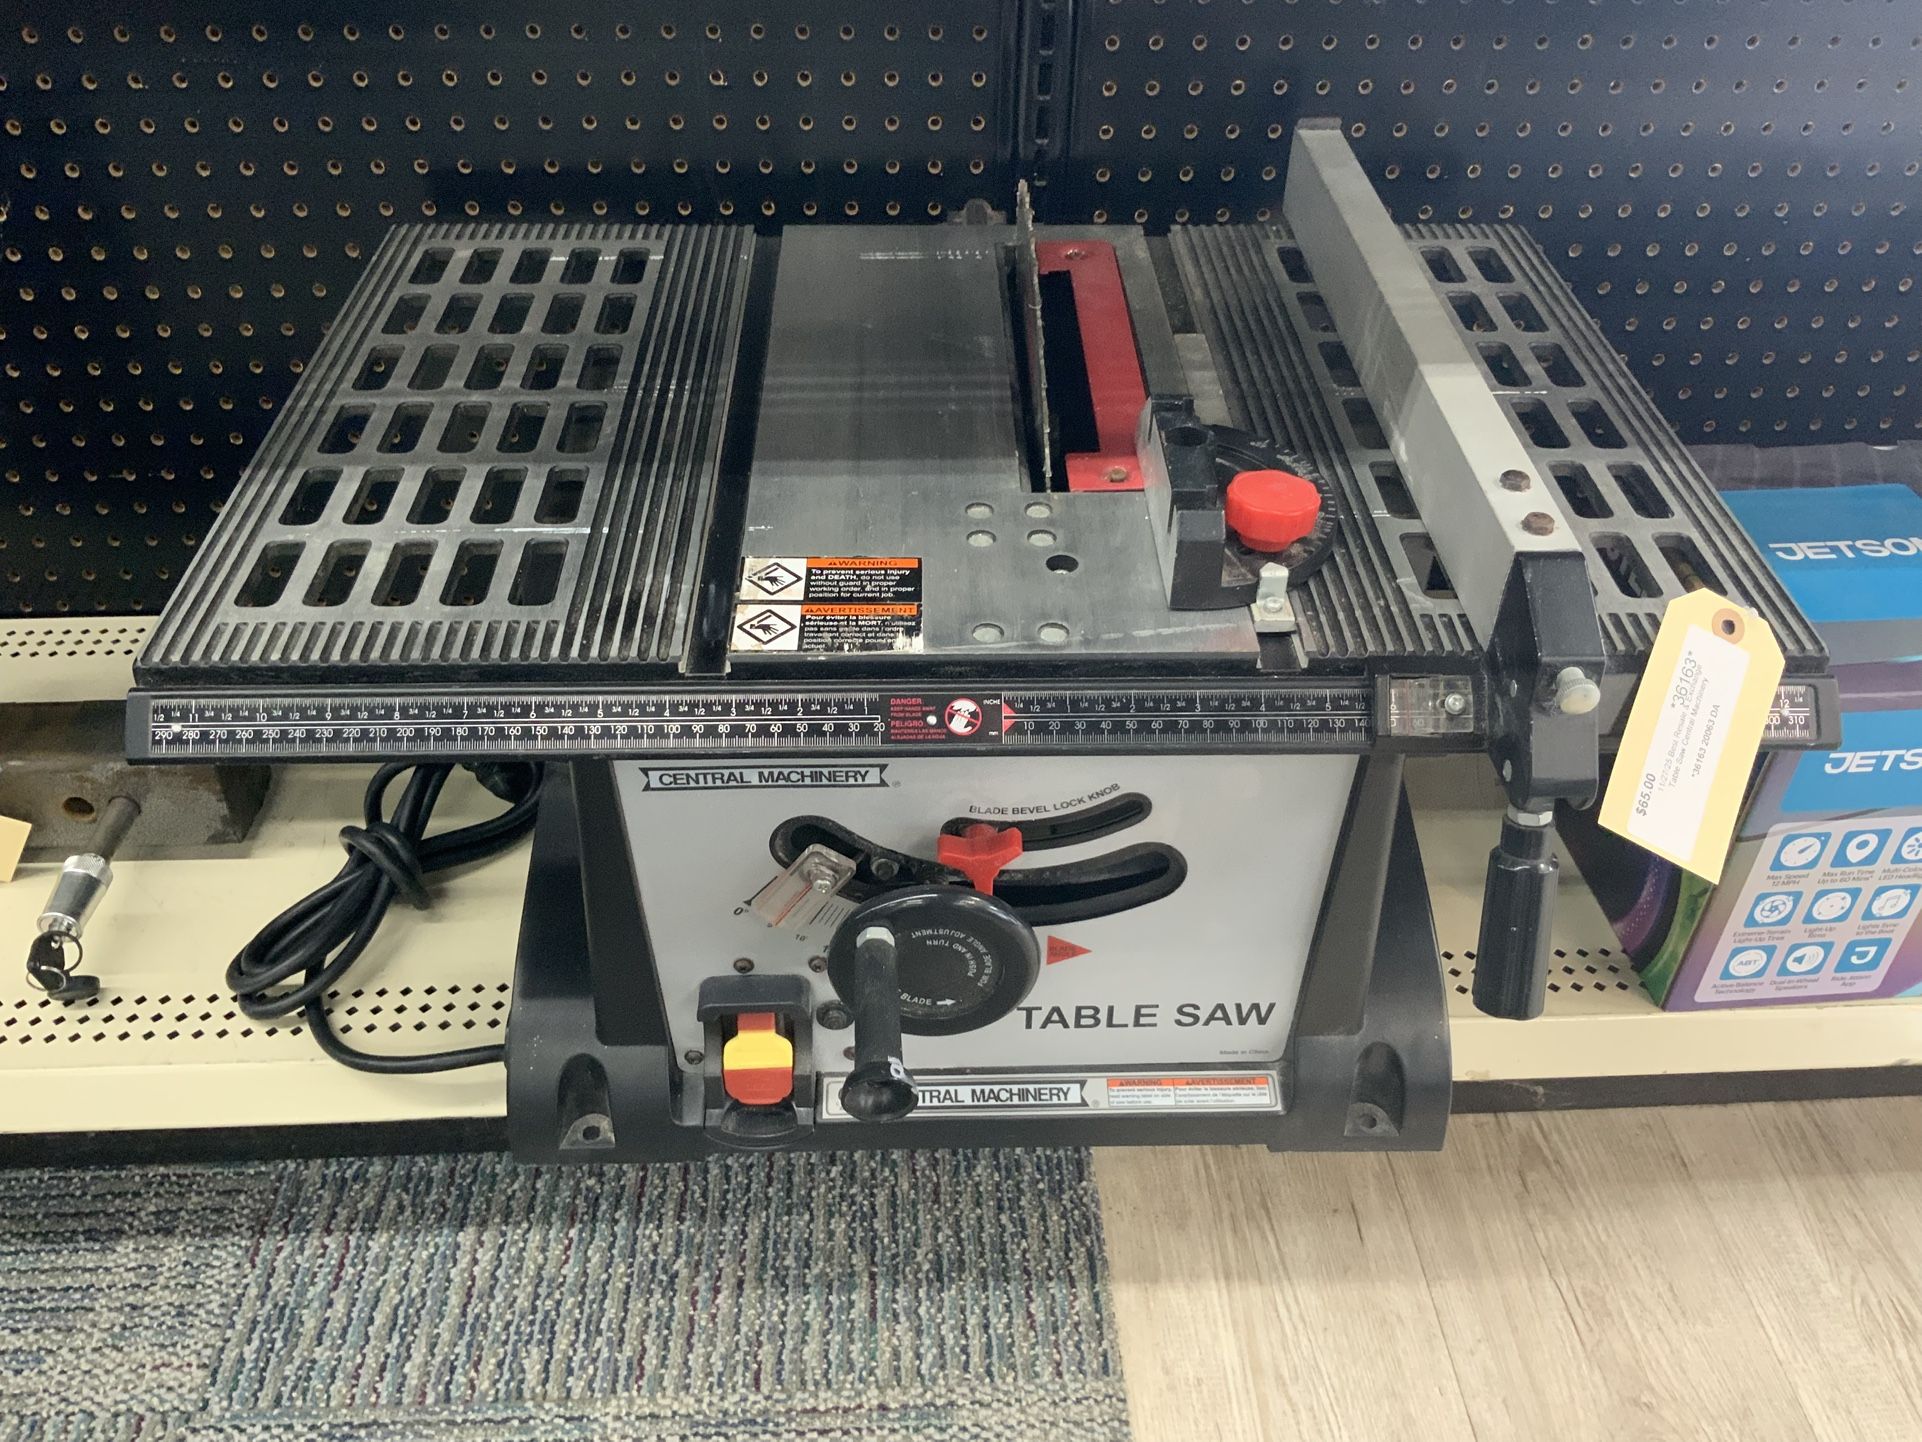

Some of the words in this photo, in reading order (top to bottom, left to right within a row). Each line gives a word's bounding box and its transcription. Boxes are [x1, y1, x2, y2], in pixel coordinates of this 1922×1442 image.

[1780, 699, 1790, 708] 12
[189, 713, 198, 722] 11
[256, 713, 267, 722] 10
[325, 712, 332, 720] 9
[394, 711, 400, 720] 8
[462, 710, 468, 719] 7
[530, 710, 536, 718] 6
[597, 709, 604, 718] 5
[663, 708, 670, 717] 4
[730, 708, 736, 716] 3
[797, 707, 803, 716] 2
[1788, 716, 1804, 724] 310
[155, 730, 172, 739] 290
[182, 730, 200, 739] 280
[210, 730, 227, 738] 270
[236, 730, 253, 738] 260
[262, 730, 280, 738] 250
[288, 729, 305, 738] 240
[316, 728, 333, 737] 230
[342, 728, 360, 737] 220
[369, 728, 386, 737] 210
[396, 728, 414, 736] 200
[424, 727, 441, 736] 190
[451, 727, 468, 736] 180
[478, 727, 495, 736] 170
[504, 726, 521, 735] 160
[531, 726, 548, 735] 150
[557, 726, 574, 734] 140
[584, 726, 601, 734] 130
[610, 726, 628, 734] 120
[637, 725, 654, 734] 110
[664, 725, 680, 734] 100
[692, 724, 704, 733] 90
[718, 724, 730, 733] 80
[745, 724, 756, 733] 70
[770, 724, 782, 732] 60
[796, 724, 808, 732] 50
[822, 723, 834, 732] 40
[848, 723, 860, 732] 30
[874, 723, 885, 732] 20
[1024, 721, 1034, 730] 10
[1049, 721, 1060, 730] 20
[1074, 721, 1086, 729] 30
[1100, 721, 1111, 729] 40
[1126, 721, 1137, 729] 50
[1151, 720, 1163, 729] 60
[1178, 720, 1189, 729] 70
[1203, 720, 1214, 728] 80
[1229, 720, 1240, 728] 90
[1252, 720, 1267, 728] 100
[1277, 719, 1294, 728] 110
[1303, 719, 1319, 727] 120
[1329, 719, 1345, 727] 130
[1669, 766, 1680, 787] Table
[1676, 748, 1686, 764] Saw
[1682, 718, 1695, 745] Central
[1691, 678, 1709, 717] Machinery
[1702, 720, 1715, 746] 20063
[1710, 704, 1720, 717] DA
[1668, 740, 1678, 757] Best
[1824, 749, 1922, 774] JETS
[658, 770, 752, 786] CENTRAL
[758, 769, 870, 784] MACHINERY
[969, 804, 1008, 815] BLADE
[1012, 804, 1051, 815] BEVEL
[1052, 796, 1086, 812] LOCK
[1087, 783, 1120, 802] KNOB
[1636, 773, 1656, 816] $65.00
[977, 975, 990, 987] FOR
[900, 992, 932, 1005] BLADE
[1016, 1004, 1160, 1030] TABLE
[1174, 1002, 1276, 1028] SAW
[918, 1088, 964, 1104] TRAL
[971, 1086, 1072, 1103] MACHINERY
